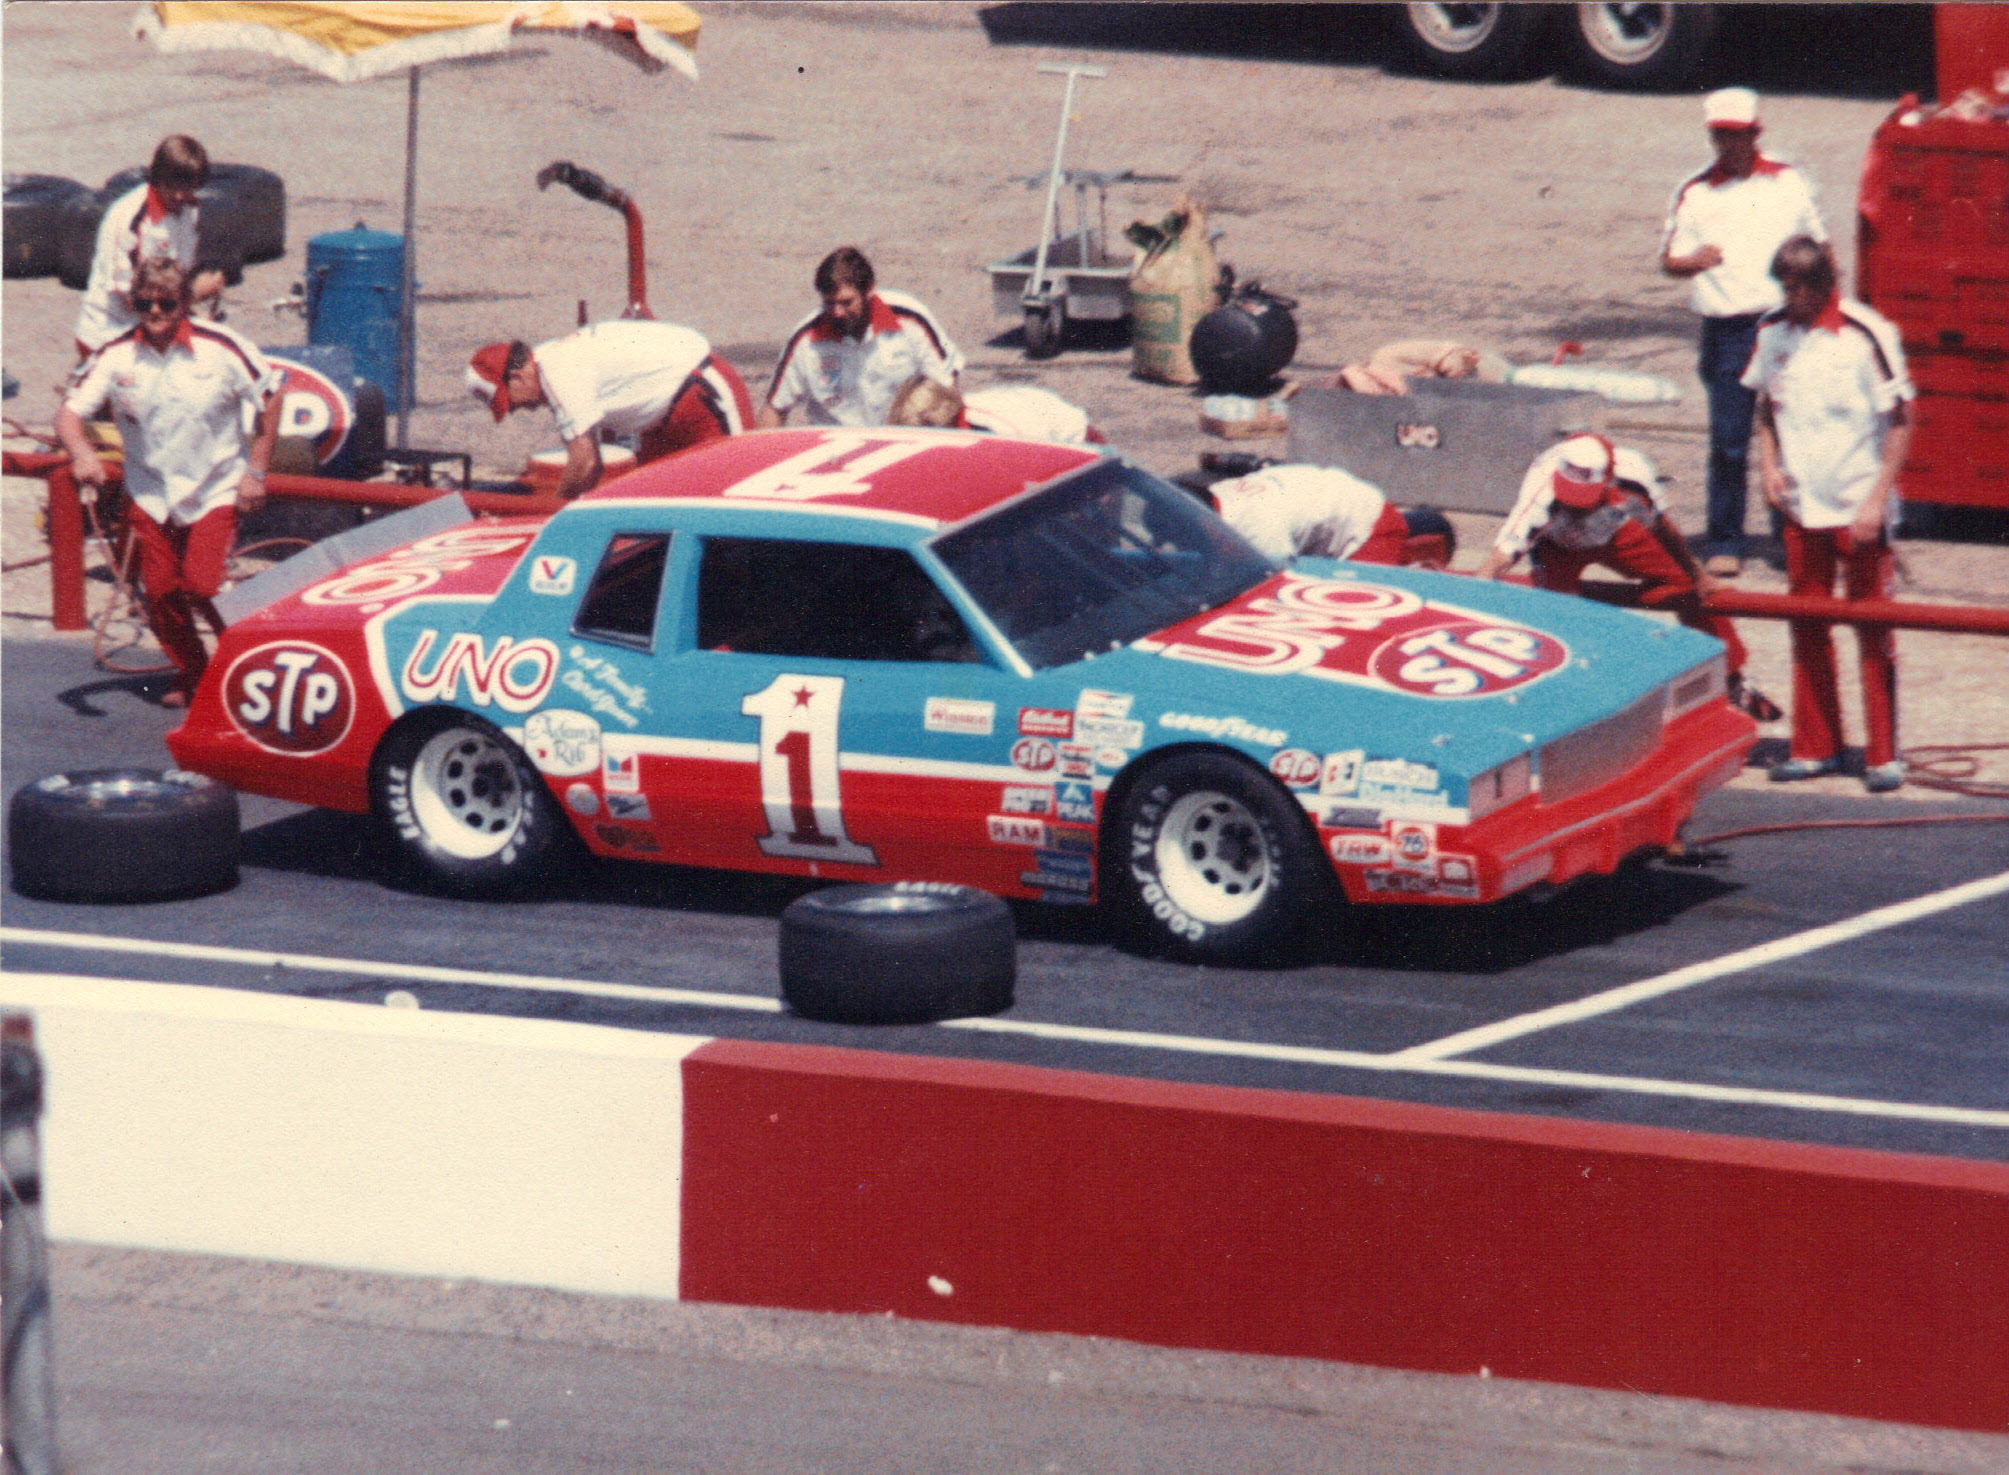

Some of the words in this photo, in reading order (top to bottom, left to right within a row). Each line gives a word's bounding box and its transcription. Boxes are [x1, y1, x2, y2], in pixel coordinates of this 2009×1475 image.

[1160, 579, 1423, 674] UNO
[1400, 628, 1541, 696] STP
[239, 652, 339, 734] STP
[401, 629, 561, 714] UNO
[741, 672, 883, 868] 1
[990, 821, 1040, 841] RAM
[1402, 834, 1426, 853] 76
